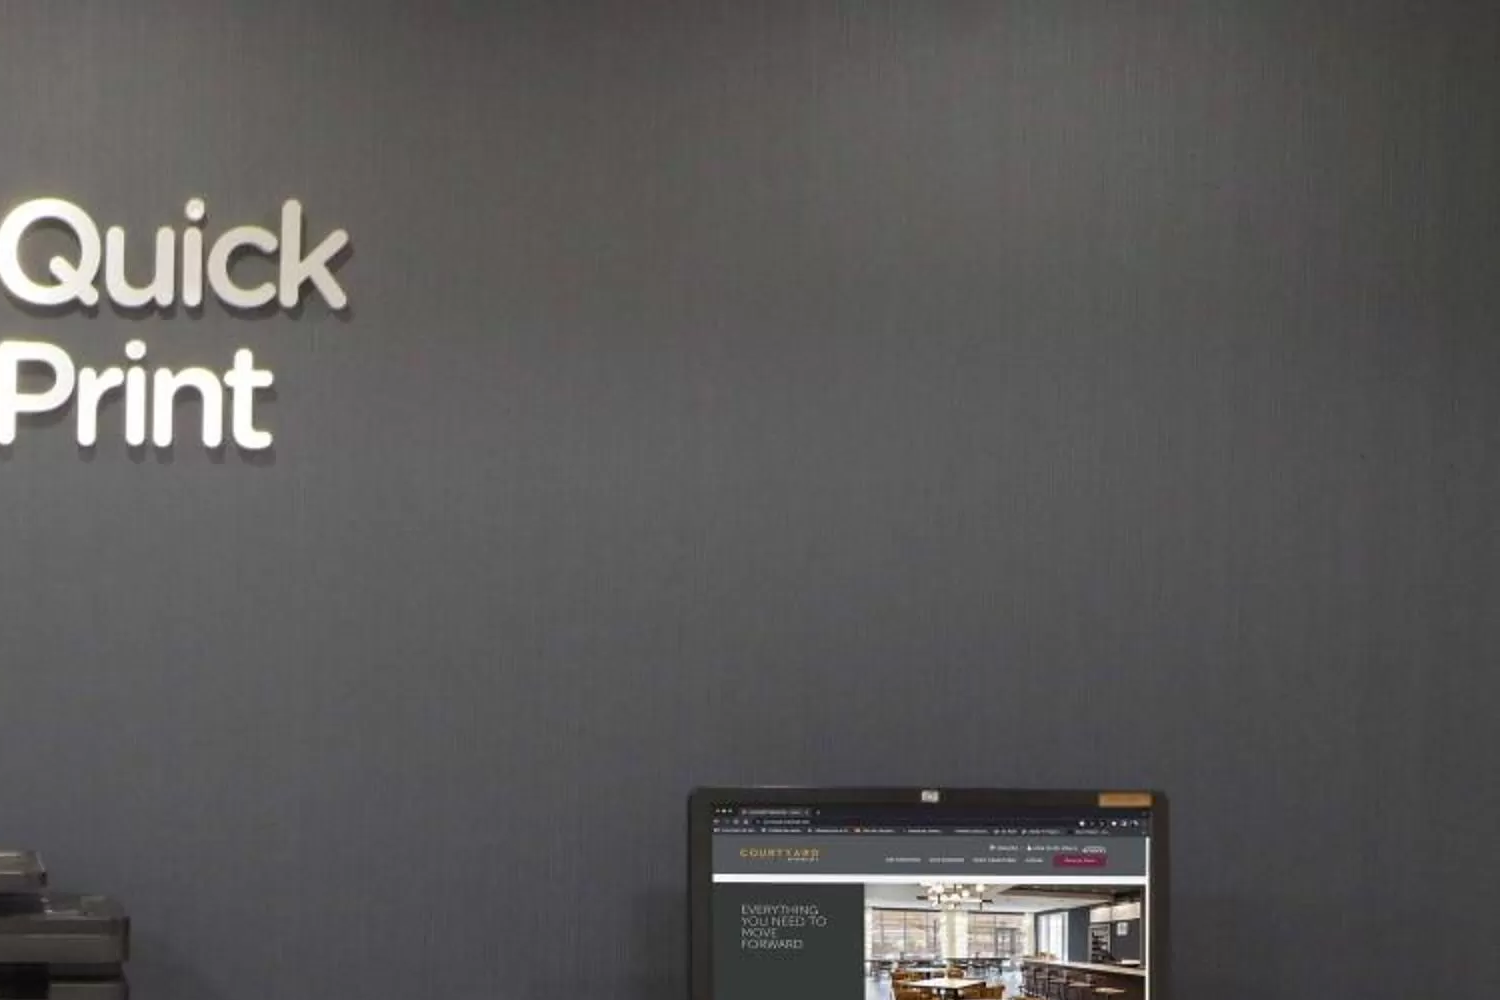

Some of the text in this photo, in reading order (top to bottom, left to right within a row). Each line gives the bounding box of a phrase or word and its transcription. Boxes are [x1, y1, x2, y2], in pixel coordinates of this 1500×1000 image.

[740, 903, 819, 915] EVERYTHING
[740, 915, 828, 927] YOU NEED TO
[740, 926, 777, 938] MOVE
[740, 938, 804, 950] FORWARD
